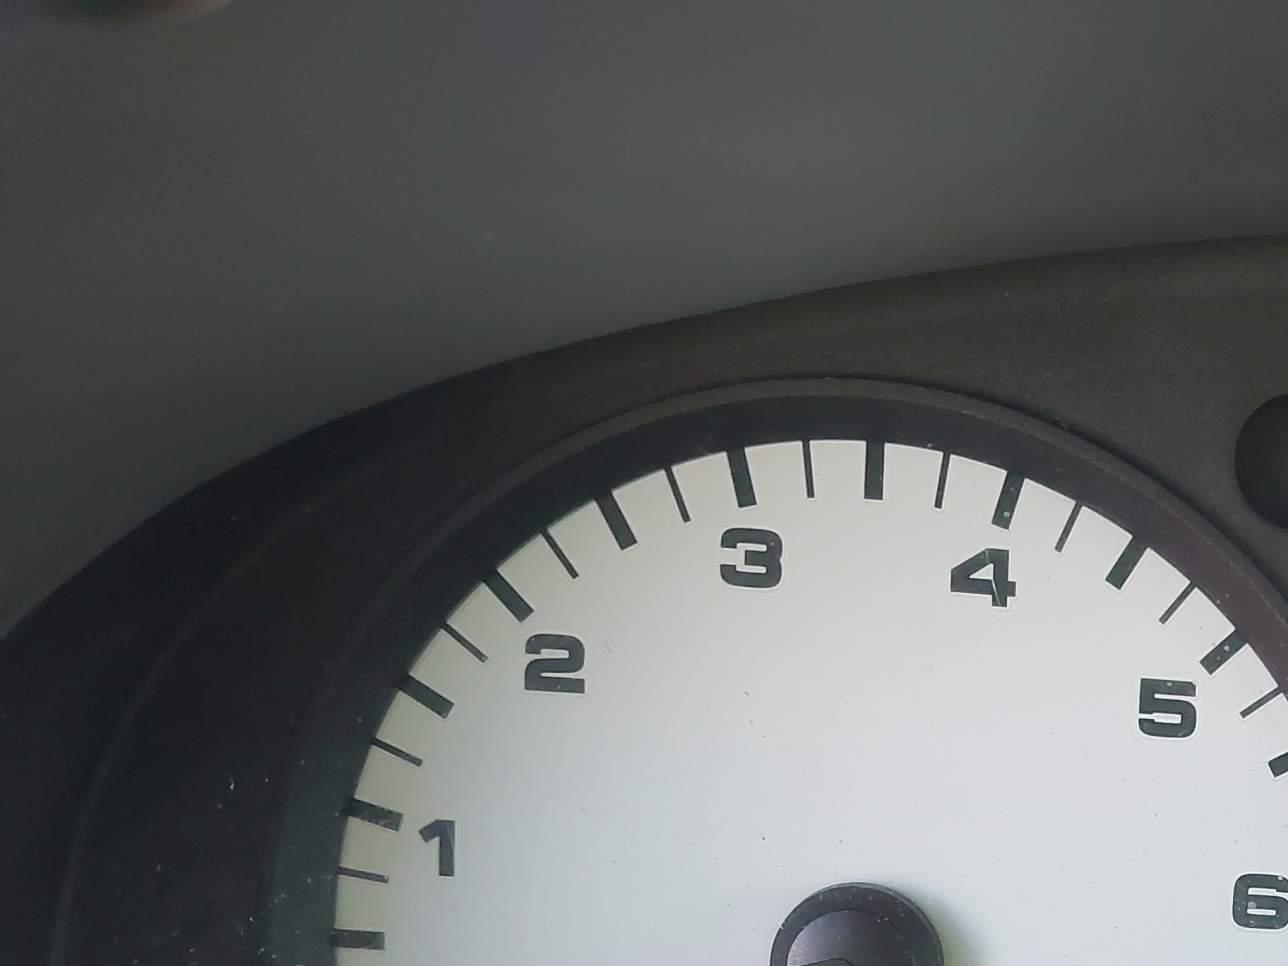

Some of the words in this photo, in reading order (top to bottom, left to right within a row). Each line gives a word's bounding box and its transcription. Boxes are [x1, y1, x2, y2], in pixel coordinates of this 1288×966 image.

[719, 527, 784, 589] 3
[950, 548, 1016, 608] 4
[524, 633, 586, 694] 2
[1138, 677, 1198, 738] 5
[419, 820, 456, 877] 1
